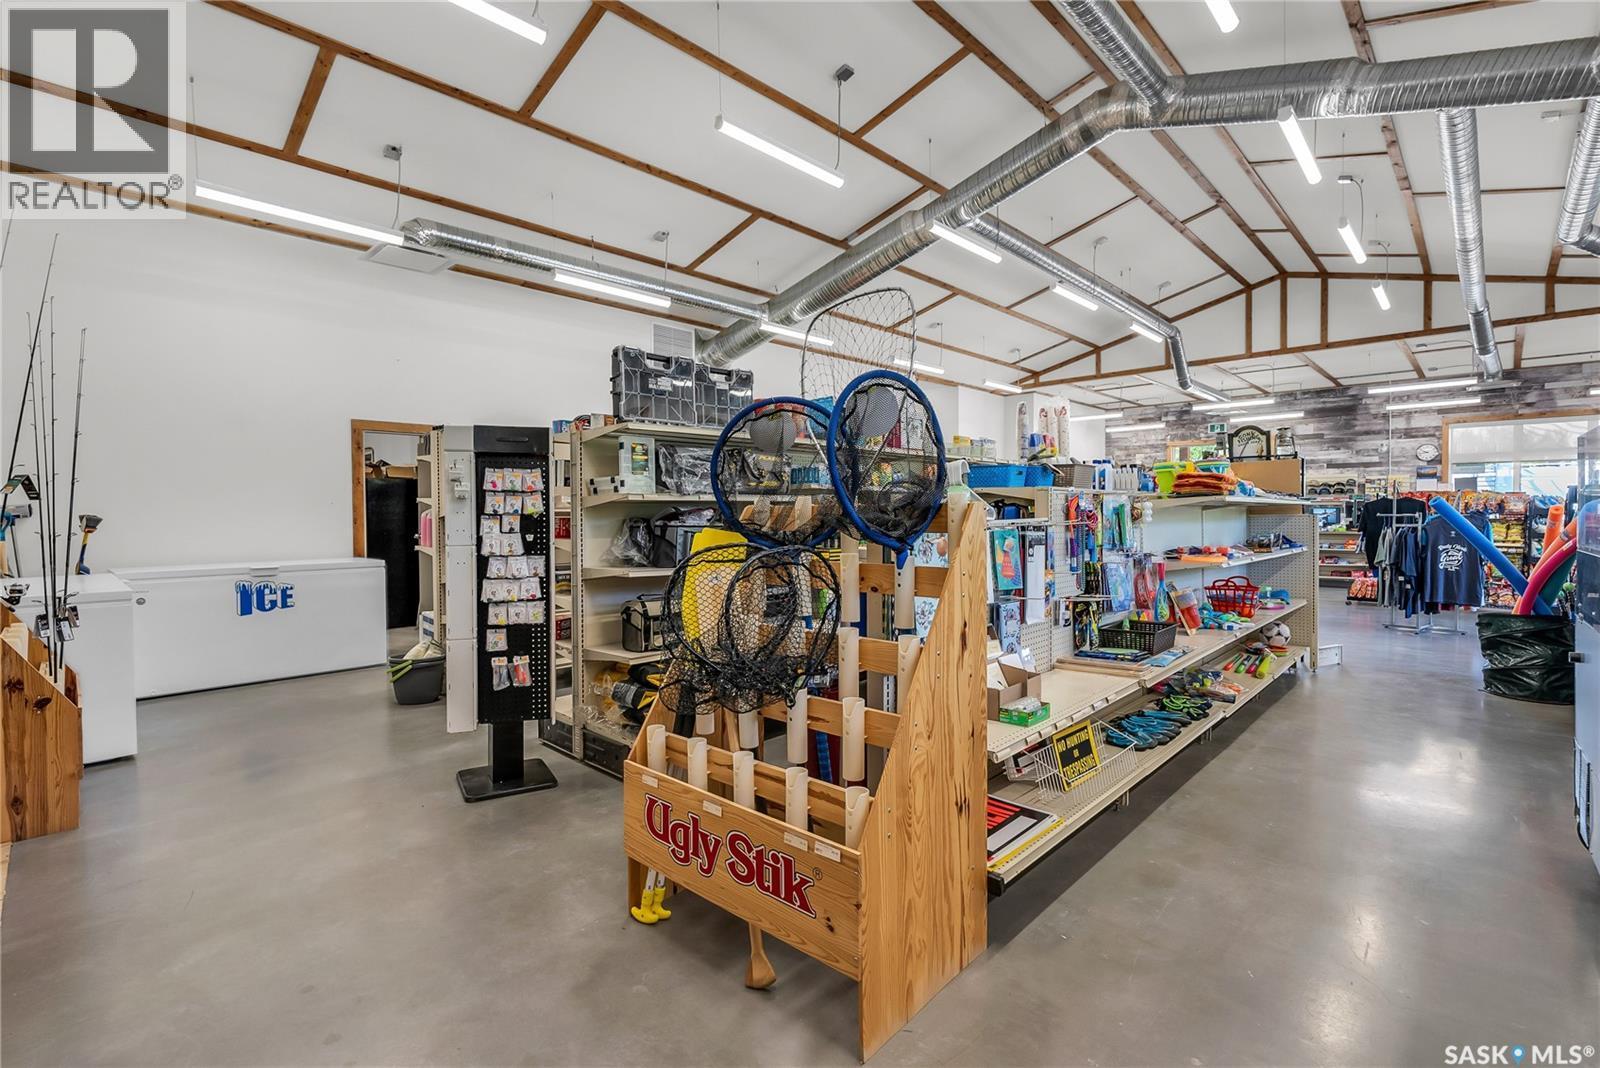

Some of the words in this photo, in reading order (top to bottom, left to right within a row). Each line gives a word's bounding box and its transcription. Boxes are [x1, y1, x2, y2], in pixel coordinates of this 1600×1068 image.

[235, 580, 295, 616] ICE
[1057, 740, 1066, 753] NO
[1066, 729, 1089, 749] HUNTING
[1063, 753, 1096, 779] TRESPASSING
[644, 792, 723, 878] Ugly
